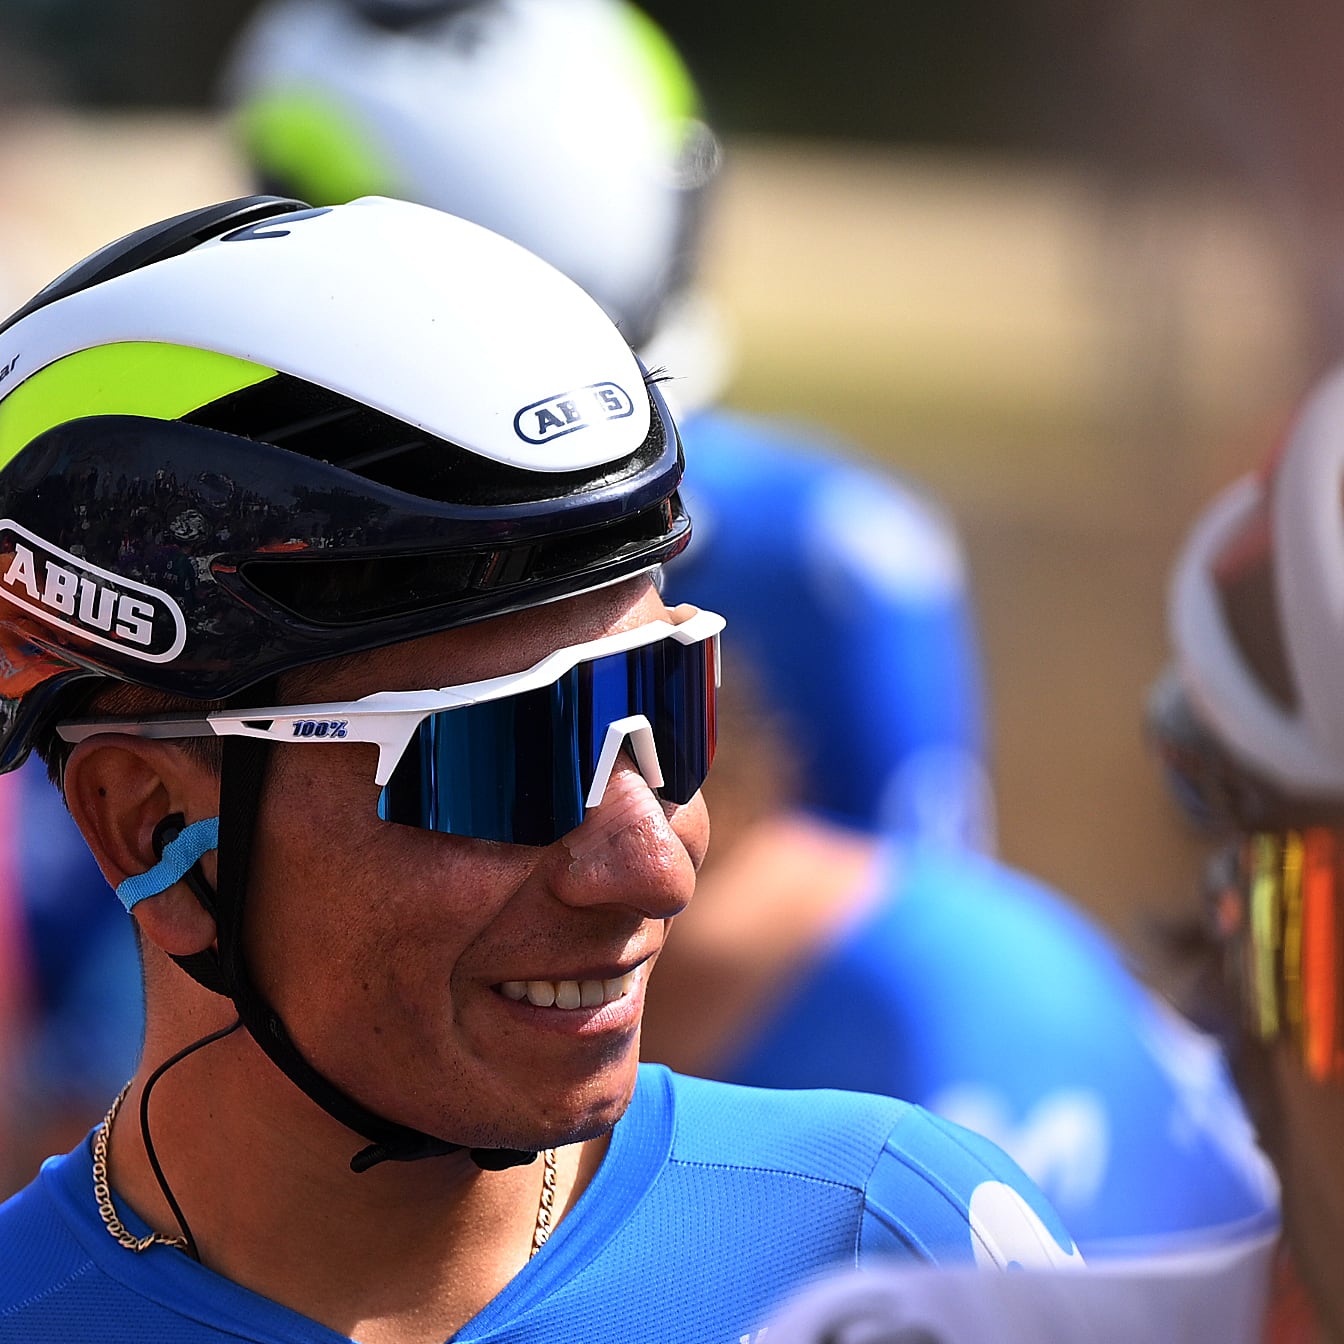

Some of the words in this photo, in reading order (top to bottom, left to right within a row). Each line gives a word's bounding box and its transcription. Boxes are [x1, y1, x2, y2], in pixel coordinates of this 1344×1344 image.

[535, 389, 622, 434] ABS
[3, 542, 155, 646] ABUS
[293, 720, 348, 738] 100%
